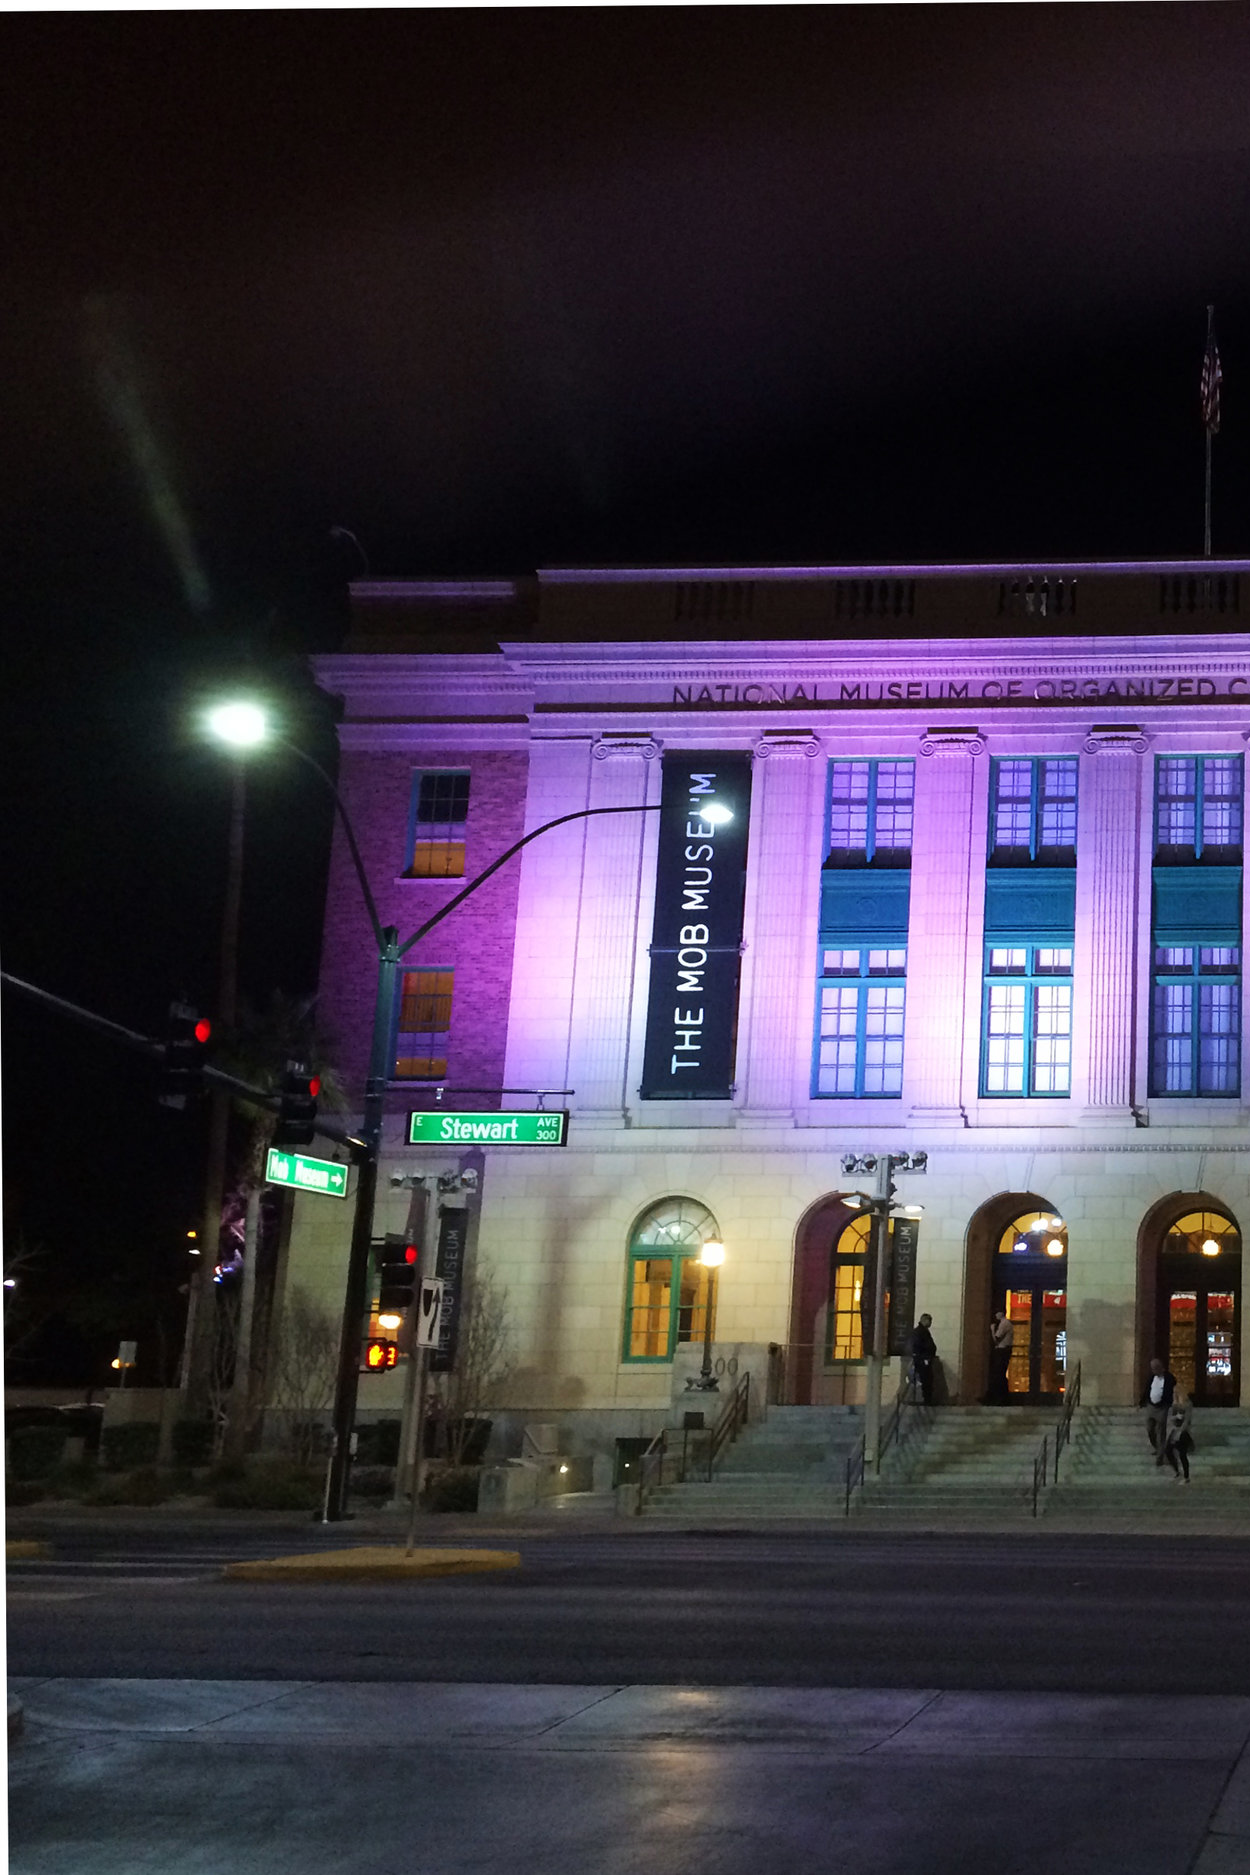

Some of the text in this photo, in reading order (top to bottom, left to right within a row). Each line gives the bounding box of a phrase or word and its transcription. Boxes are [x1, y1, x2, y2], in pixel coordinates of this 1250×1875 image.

[673, 684, 819, 703] NATIONAL
[840, 682, 968, 701] MUSEUM
[982, 681, 1021, 699] OF
[1035, 678, 1217, 699] ORGANIZED
[676, 923, 709, 992] MOB
[671, 1007, 704, 1074] THE
[416, 1116, 559, 1140] E Stewart AVE
[535, 1130, 557, 1140] 300
[443, 1229, 460, 1290] MUSEUM
[897, 1226, 912, 1282] MUSEUM
